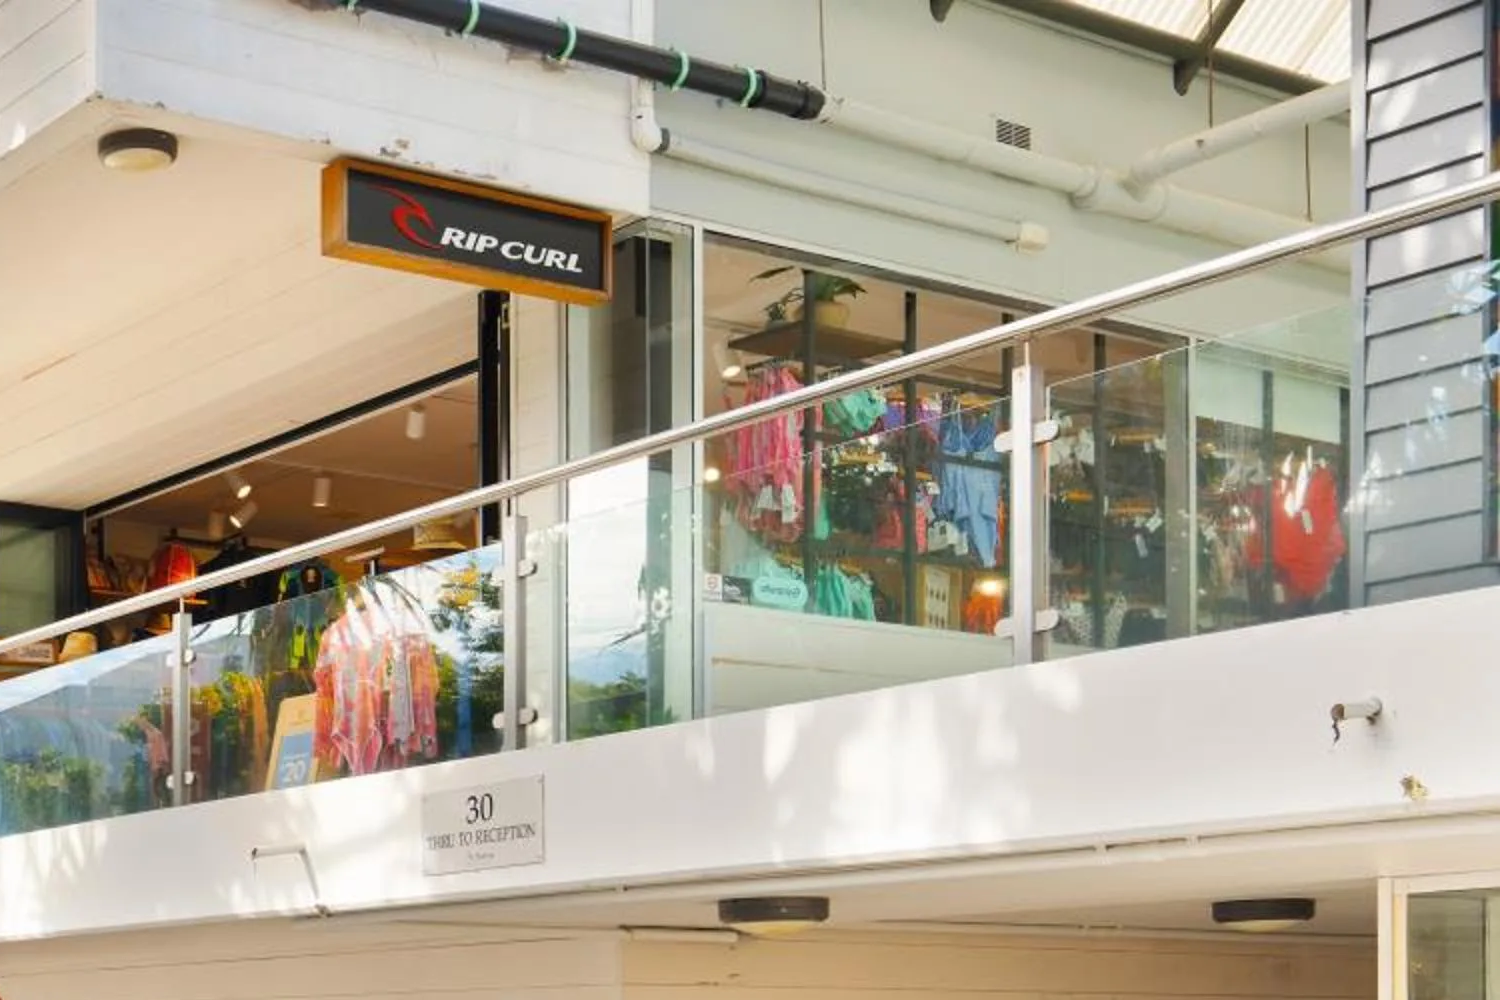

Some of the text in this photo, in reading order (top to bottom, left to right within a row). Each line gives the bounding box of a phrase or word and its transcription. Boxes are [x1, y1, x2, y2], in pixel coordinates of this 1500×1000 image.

[440, 227, 582, 273] RIP CURL
[466, 793, 493, 824] 30
[426, 823, 535, 850] THRU TO RECEPTION
